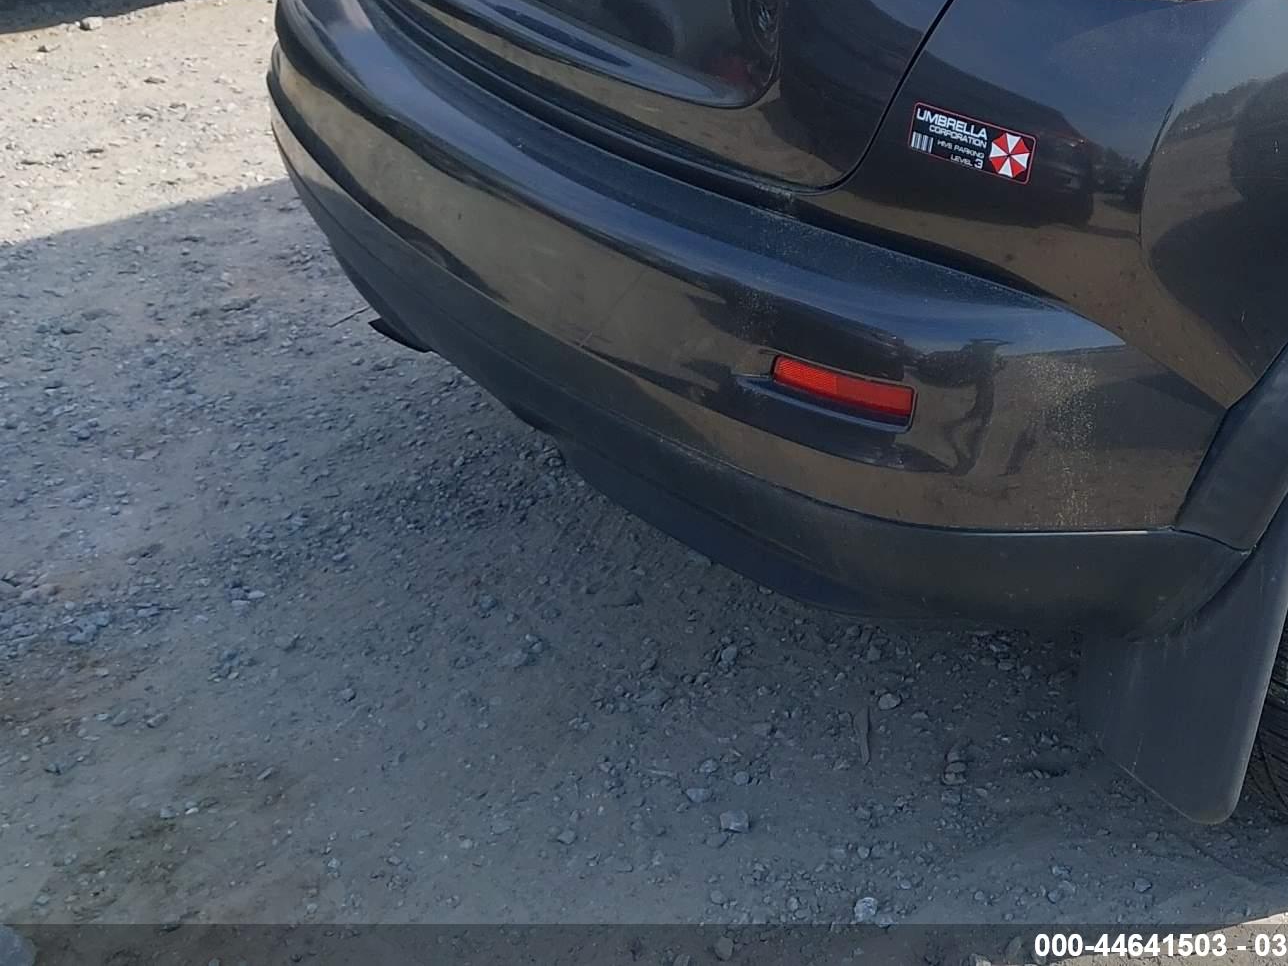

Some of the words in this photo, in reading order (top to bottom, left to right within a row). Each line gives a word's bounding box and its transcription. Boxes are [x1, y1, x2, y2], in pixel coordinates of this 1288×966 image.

[916, 107, 988, 141] UMBRELLA
[929, 125, 988, 149] CORPORATION
[950, 153, 973, 167] LEVEL
[974, 158, 984, 169] 3
[953, 144, 985, 159] PARKING
